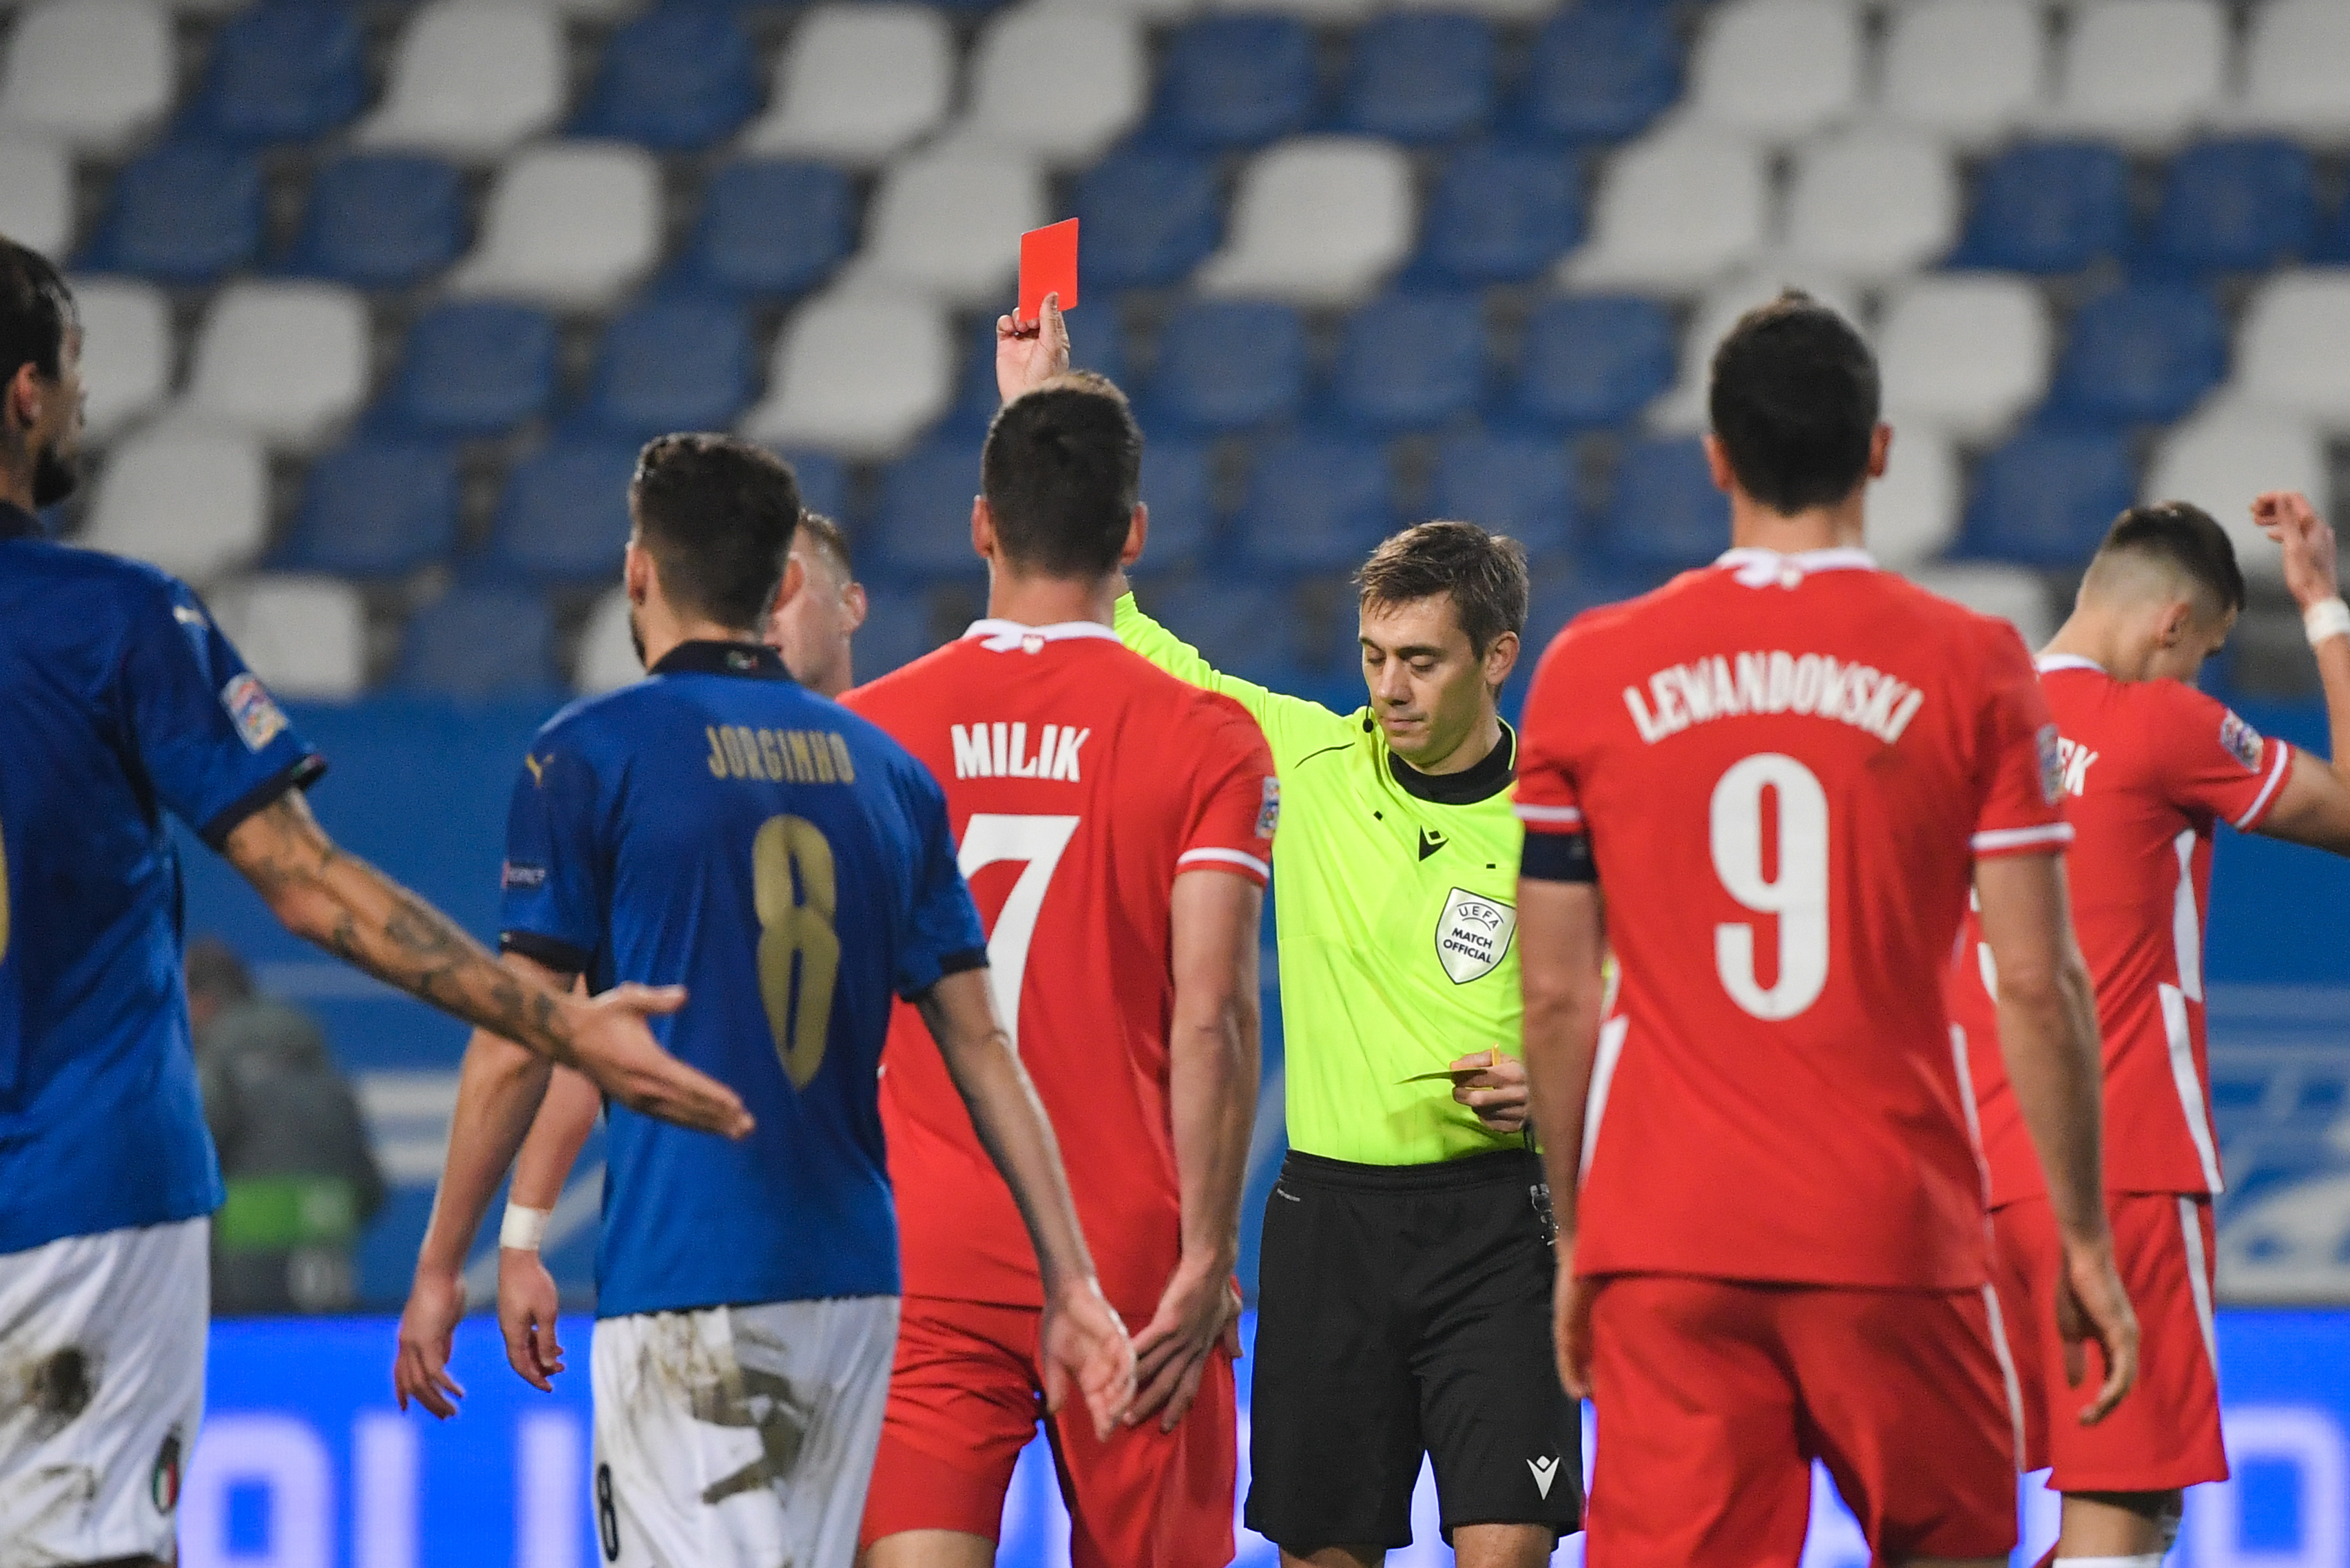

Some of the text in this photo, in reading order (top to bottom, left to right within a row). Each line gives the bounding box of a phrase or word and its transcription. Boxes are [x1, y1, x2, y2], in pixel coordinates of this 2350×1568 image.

[1621, 649, 1924, 745] LEWANDOWSKI
[706, 725, 855, 784] JORGINHO
[950, 722, 1092, 783] MILIK
[1458, 906, 1499, 929] UEFA
[1709, 752, 1830, 1022] 9
[751, 814, 841, 1094] 8
[957, 813, 1081, 1056] 7
[1443, 938, 1492, 964] OFFICIAL
[1451, 927, 1493, 949] MATCH
[596, 1462, 619, 1562] 8
